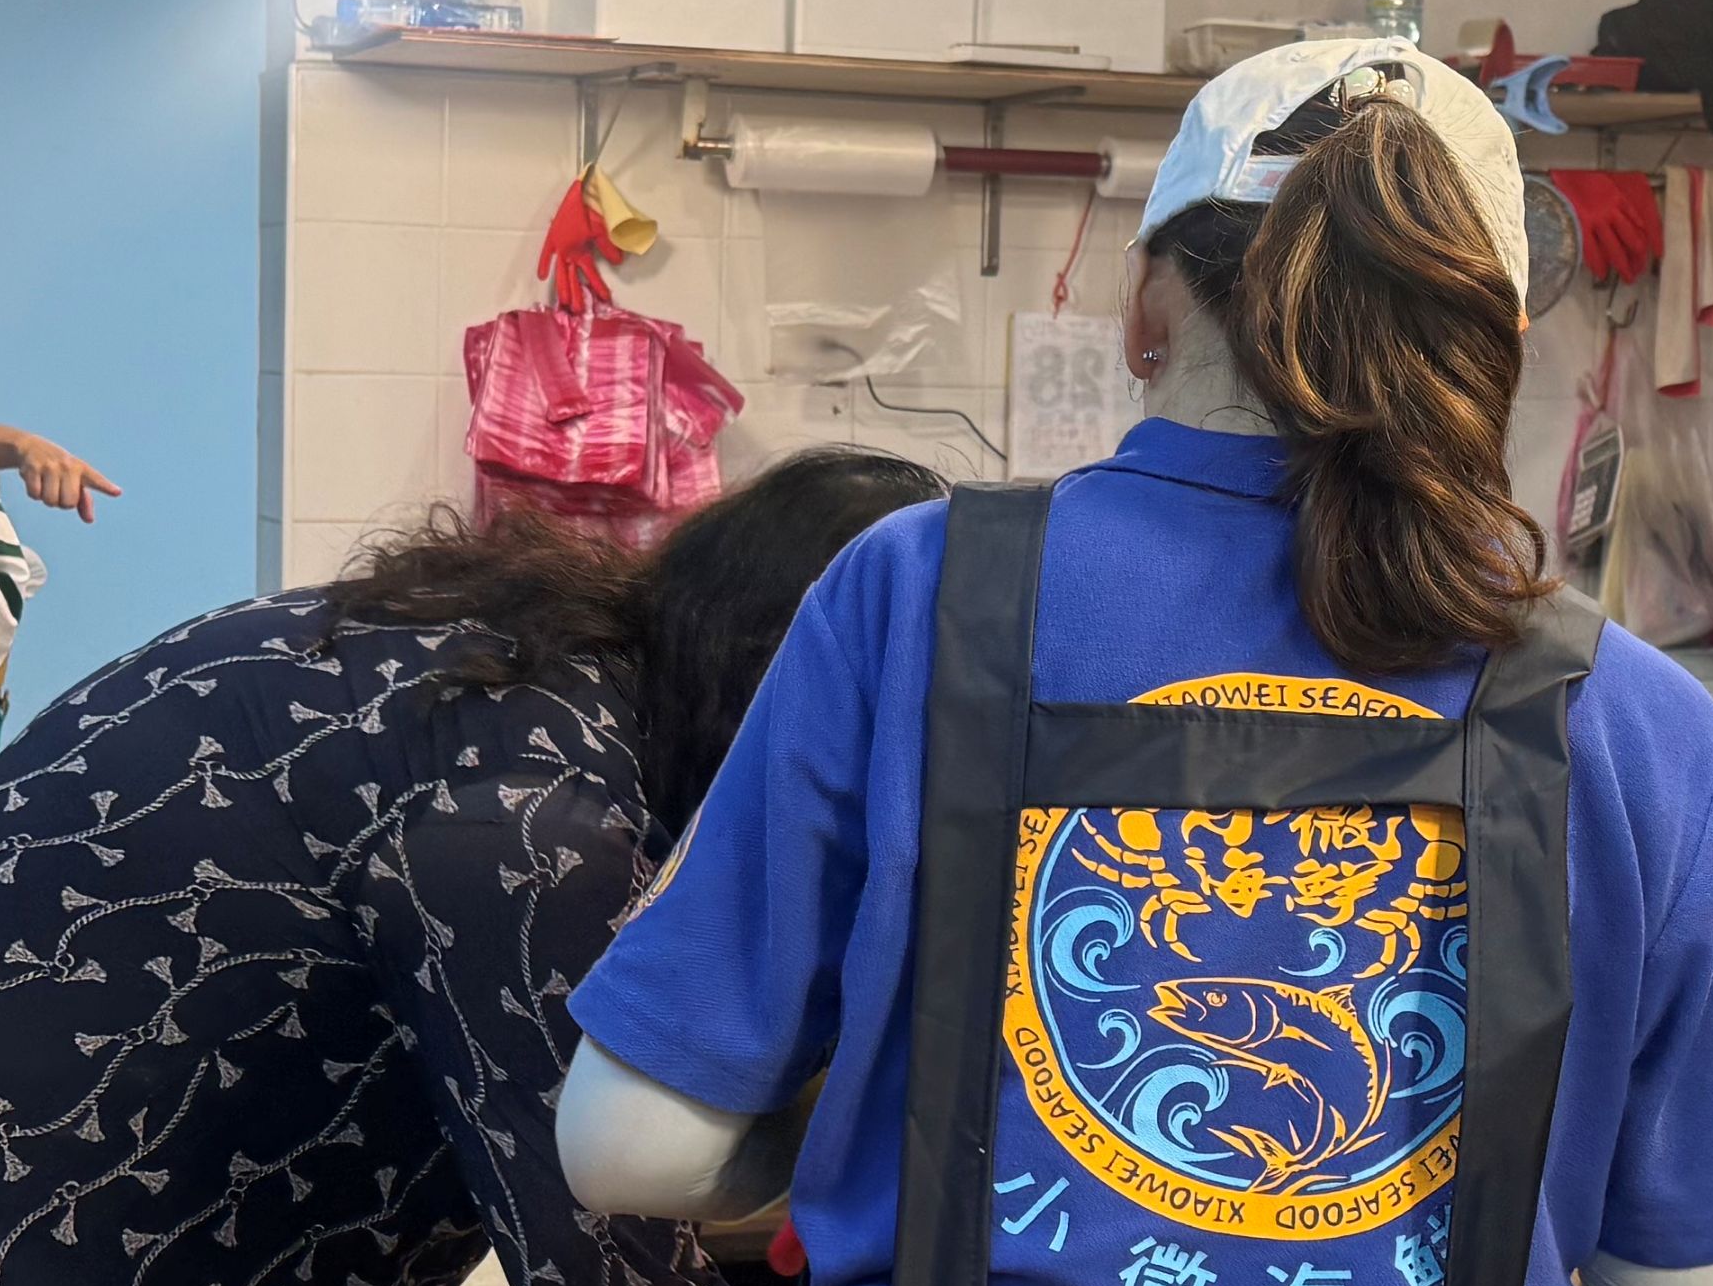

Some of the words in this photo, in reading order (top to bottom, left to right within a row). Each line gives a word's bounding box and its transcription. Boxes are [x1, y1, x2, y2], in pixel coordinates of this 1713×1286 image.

[1014, 1026, 1106, 1155] SEAFOOD
[1102, 1149, 1245, 1226] XIAOWEI
[1275, 1170, 1416, 1231] SEAFOOD
